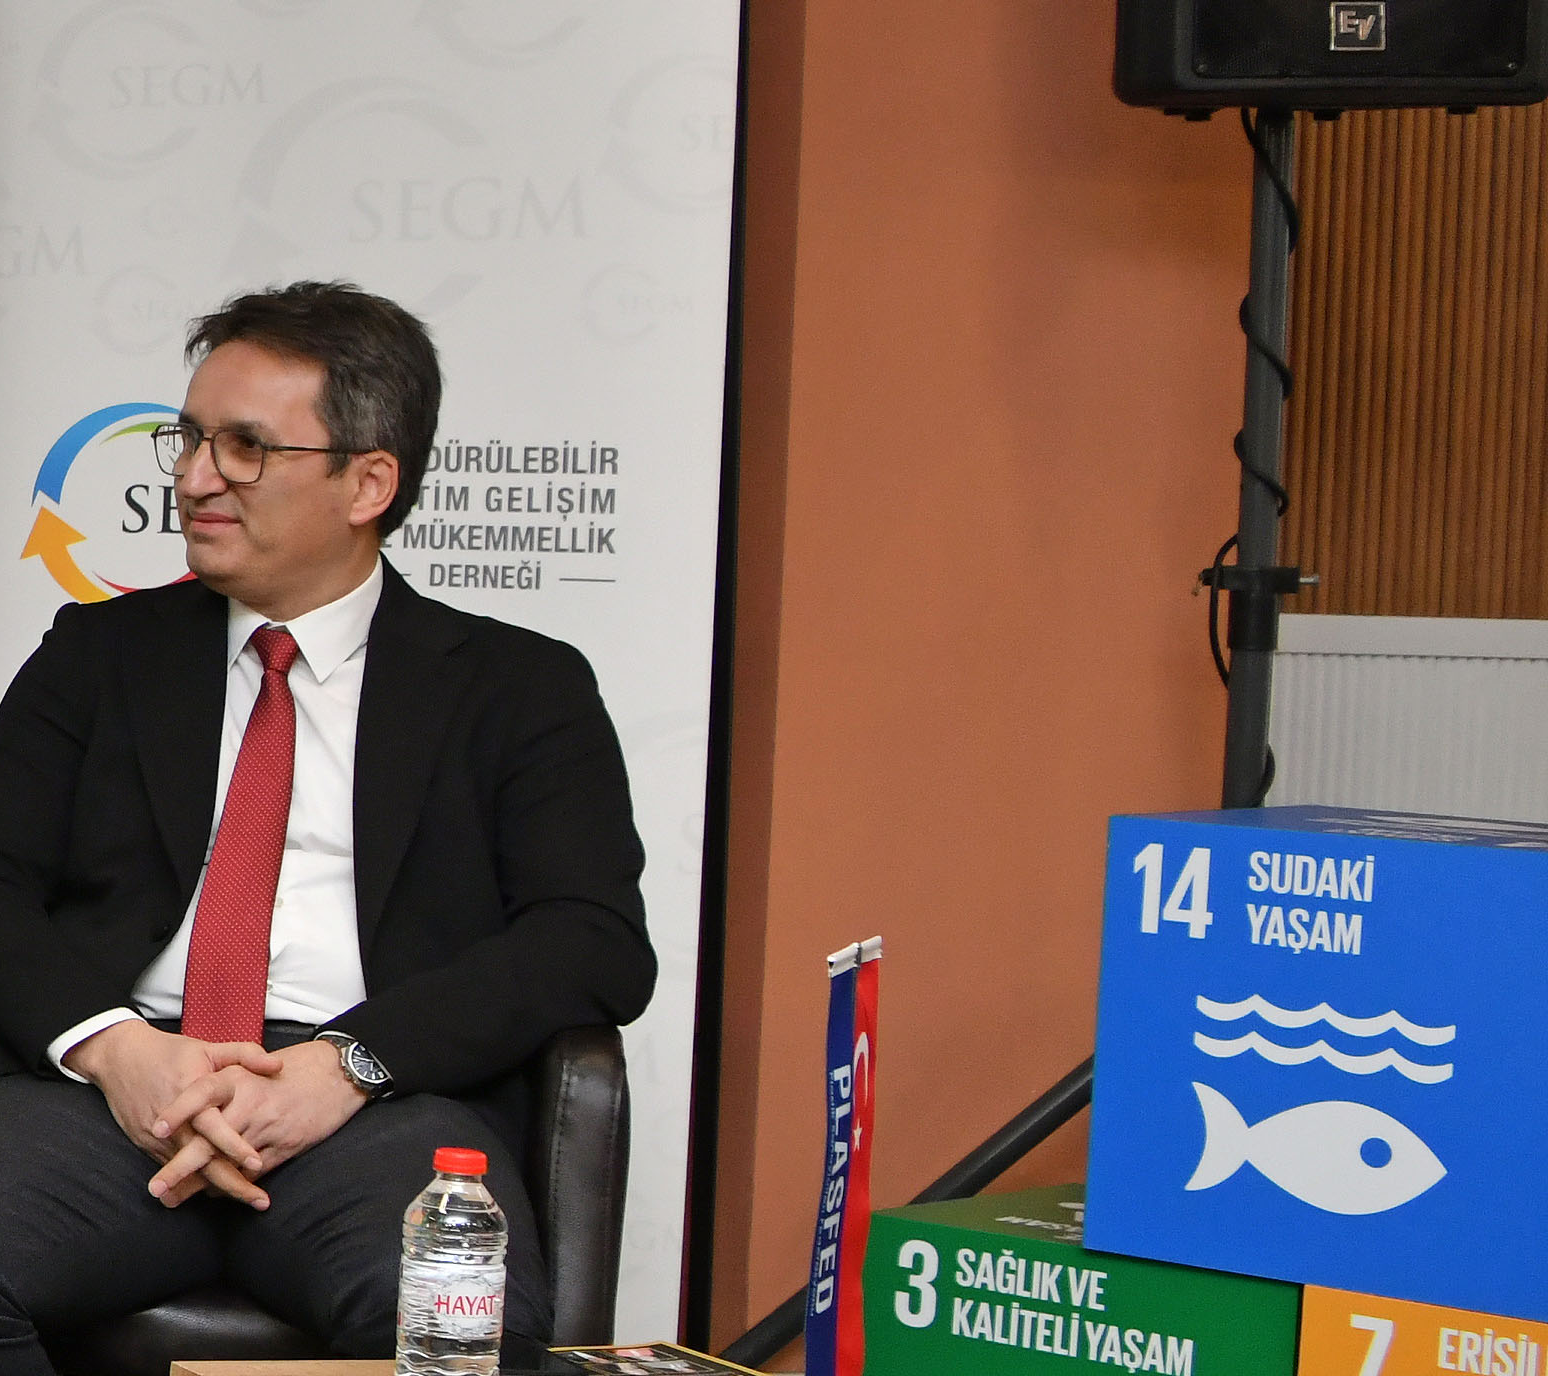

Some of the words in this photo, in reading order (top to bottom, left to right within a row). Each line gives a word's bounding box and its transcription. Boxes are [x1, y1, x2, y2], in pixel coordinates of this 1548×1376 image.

[345, 173, 591, 243] SEGM
[426, 439, 619, 475] DÜRÜLEBİLİR
[122, 484, 182, 534] SE
[417, 480, 469, 512] TİM
[485, 481, 616, 521] GELİŞİM
[403, 519, 616, 554] MÜKEMMELLİK
[429, 560, 542, 590] DERNEĞİ
[1132, 843, 1213, 940] 14
[1248, 850, 1375, 904] SUDAKİ
[1247, 903, 1363, 958] YAŞAM
[815, 1064, 853, 1314] PLASFED
[434, 1294, 496, 1315] HAYAT
[893, 1238, 940, 1330] 3
[955, 1245, 1061, 1305] SAĞLIK
[1067, 1270, 1106, 1312] VE
[952, 1295, 1081, 1356] KALİTELİ
